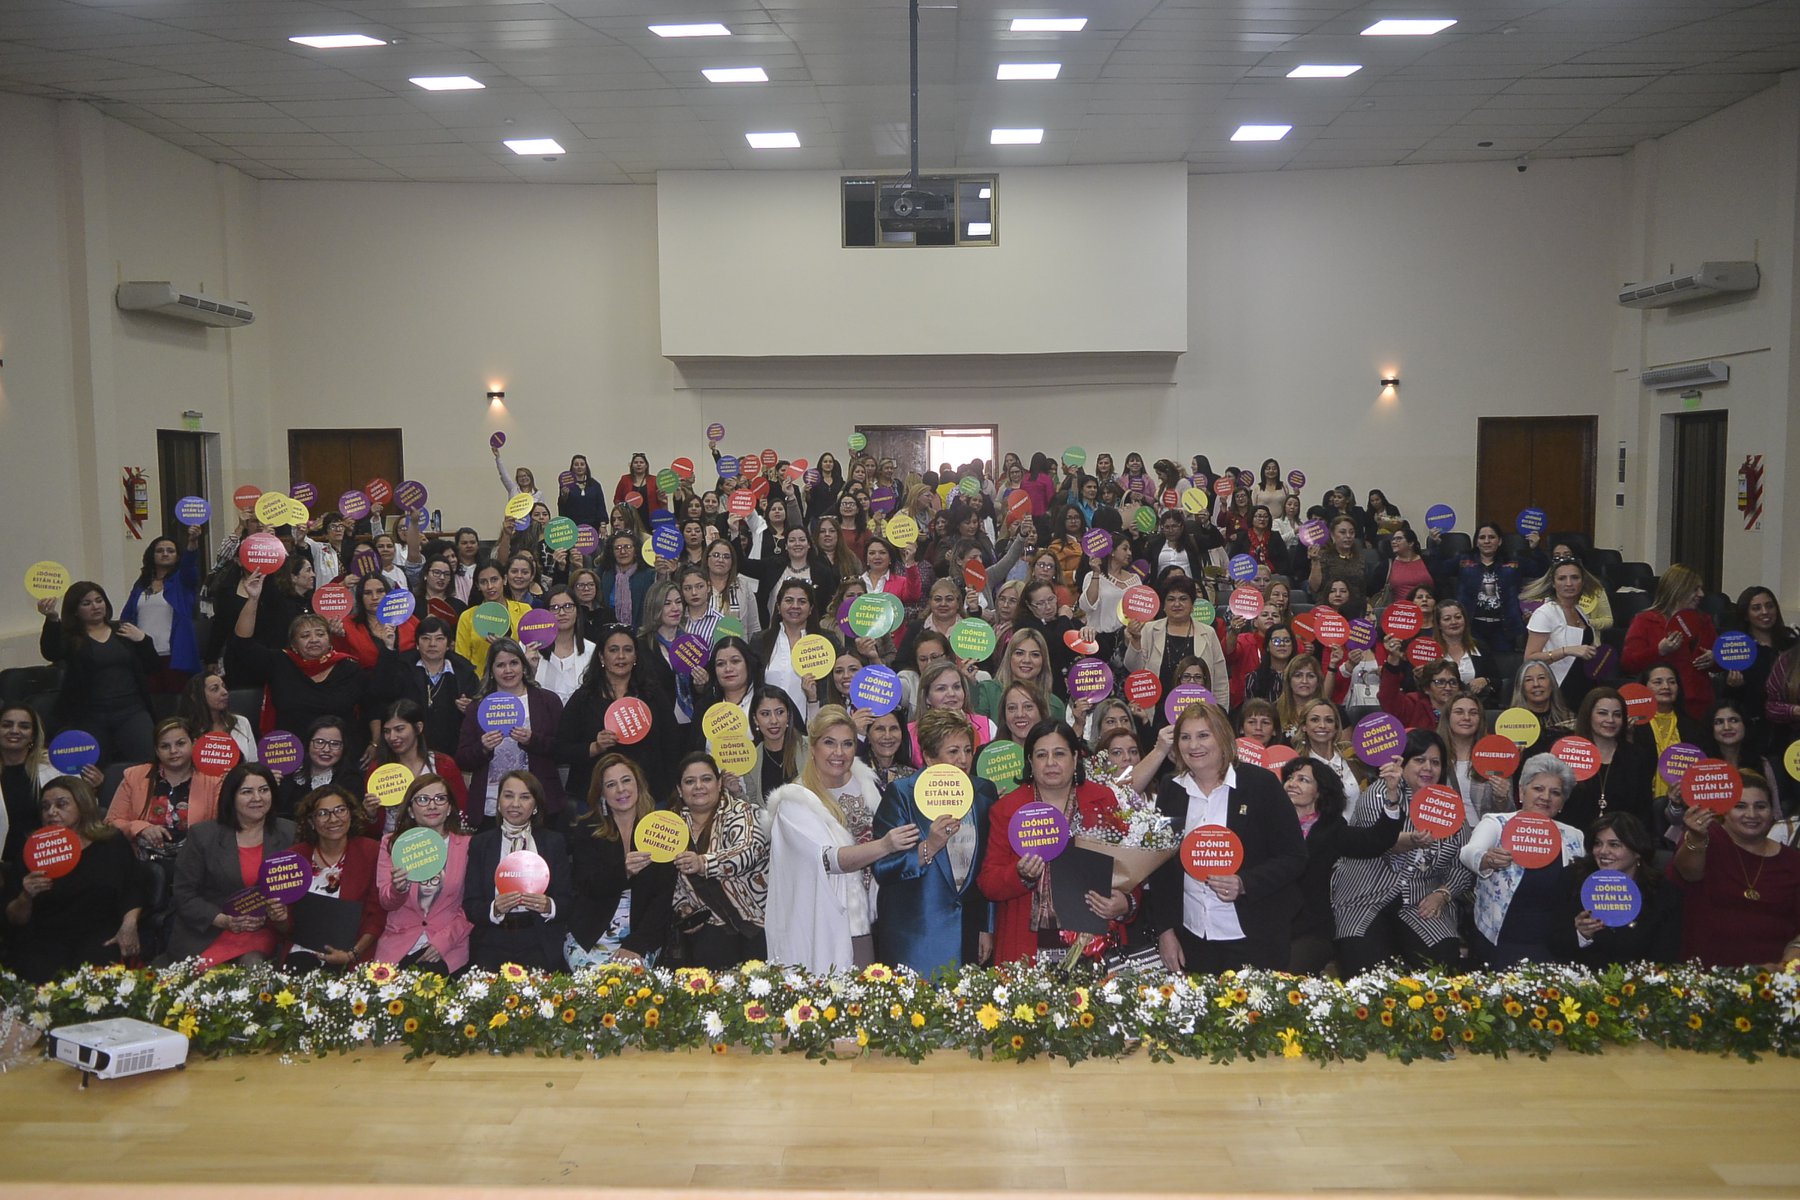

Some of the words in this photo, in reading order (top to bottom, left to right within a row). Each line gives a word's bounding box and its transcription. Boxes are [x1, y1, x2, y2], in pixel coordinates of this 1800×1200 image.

[32, 583, 62, 591] MUJERES?
[800, 645, 825, 655] ¿DÓNDE
[798, 654, 818, 663] ESTÁN
[801, 658, 829, 670] MUJERES?
[1077, 669, 1103, 677] ¿DÓNDE
[864, 676, 893, 689] ¿DÓNDE
[1076, 683, 1105, 692] MUJERES?
[858, 682, 881, 694] ESTÁN
[881, 689, 894, 698] LAS
[858, 690, 891, 705] MUJERES?
[613, 710, 630, 738] MUJERES?
[619, 706, 632, 726] ESTÁN
[628, 725, 637, 737] LAS
[627, 706, 643, 731] ¿DÓNDE
[1363, 723, 1392, 739] ¿DÓNDE
[1361, 735, 1384, 748] ESTÁN
[1384, 730, 1398, 740] LAS
[52, 744, 95, 755] #MUJERESPY
[204, 742, 231, 751] ¿DÓNDE
[266, 741, 293, 750] ¿DÓNDE
[1366, 739, 1399, 756] MUJERES?
[200, 749, 221, 757] ESTÁN
[264, 749, 285, 757] ESTÁN
[1562, 747, 1591, 756] ¿DÓNDE
[200, 757, 231, 765] MUJERES?
[267, 755, 296, 764] MUJERES?
[377, 772, 403, 784] ¿DÓNDE
[1694, 773, 1729, 782] ¿DÓNDE
[375, 781, 395, 791] ESTÁN
[928, 779, 960, 788] ¿DÓNDE
[1691, 782, 1717, 791] ESTÁN
[924, 788, 949, 797] ESTÁN
[1693, 791, 1732, 800] MUJERES?
[1425, 796, 1456, 810] ¿DÓNDE
[1419, 803, 1442, 816] ESTÁN
[1443, 810, 1457, 820] LAS
[1021, 817, 1055, 828] ¿DÓNDE
[1418, 812, 1453, 827] MUJERES?
[651, 822, 680, 837] ¿DÓNDE
[1018, 828, 1044, 838] ESTÁN
[1045, 827, 1060, 835] LAS
[1516, 826, 1549, 836] ¿DÓNDE
[644, 828, 667, 841] ESTÁN
[666, 836, 680, 846] LAS
[1021, 836, 1059, 848] MUJERES?
[1511, 835, 1537, 844] ESTÁN
[1538, 837, 1553, 845] LAS
[36, 836, 68, 850] ¿DÓNDE
[402, 838, 432, 854] ¿DÓNDE
[642, 836, 676, 853] MUJERES?
[1195, 839, 1230, 848] ¿DÓNDE
[33, 848, 58, 859] ESTÁN
[58, 844, 73, 853] LAS
[401, 850, 424, 864] ESTÁN
[424, 845, 438, 855] LAS
[1191, 849, 1217, 857] ESTÁN
[1512, 844, 1551, 854] MUJERES?
[36, 852, 73, 867] MUJERES?
[268, 863, 299, 875] ¿DÓNDE
[265, 873, 289, 884] ESTÁN
[290, 870, 304, 879] LAS
[268, 879, 303, 892] MUJERES?
[1594, 884, 1628, 892] ¿DÓNDE
[1591, 893, 1617, 902] ESTÁN
